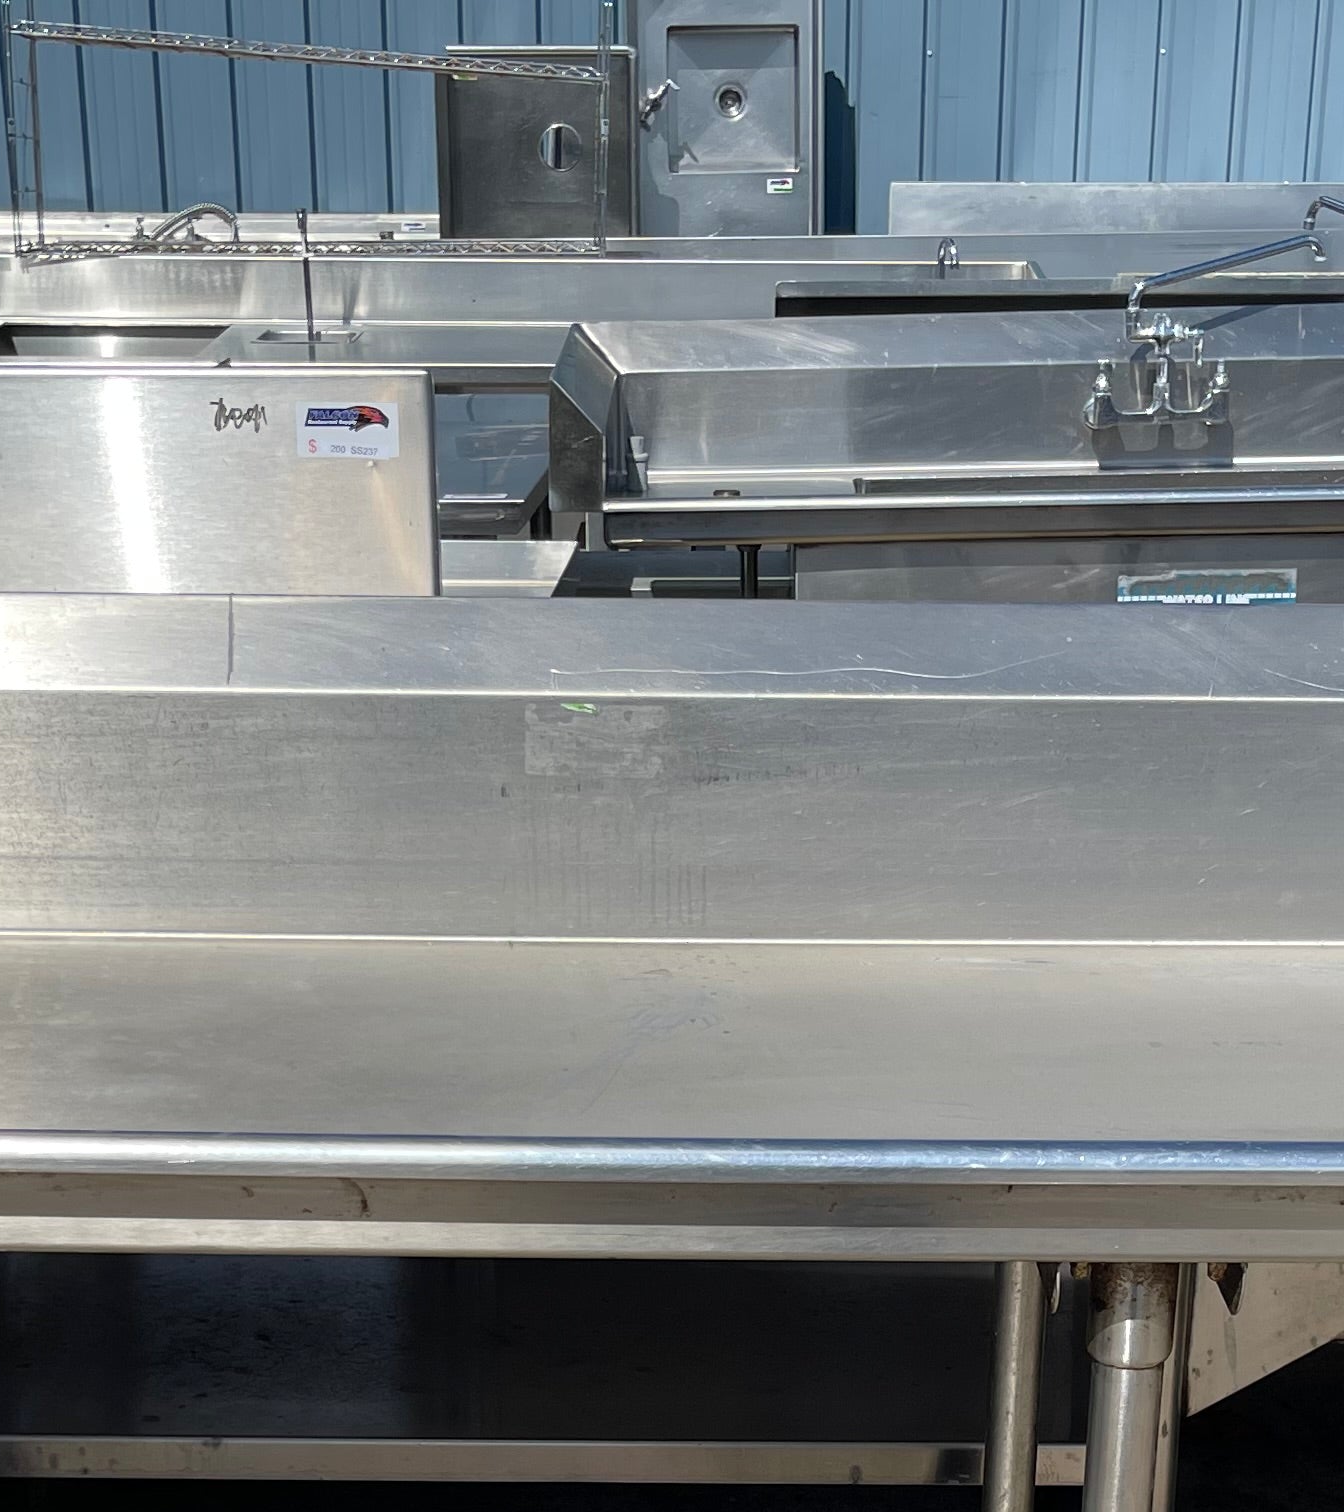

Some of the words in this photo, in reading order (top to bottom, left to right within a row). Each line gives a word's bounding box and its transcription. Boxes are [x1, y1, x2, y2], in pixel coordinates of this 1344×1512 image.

[309, 409, 359, 419] FALCON
[308, 438, 318, 454] $
[331, 445, 346, 453] 200
[350, 446, 378, 455] SS237
